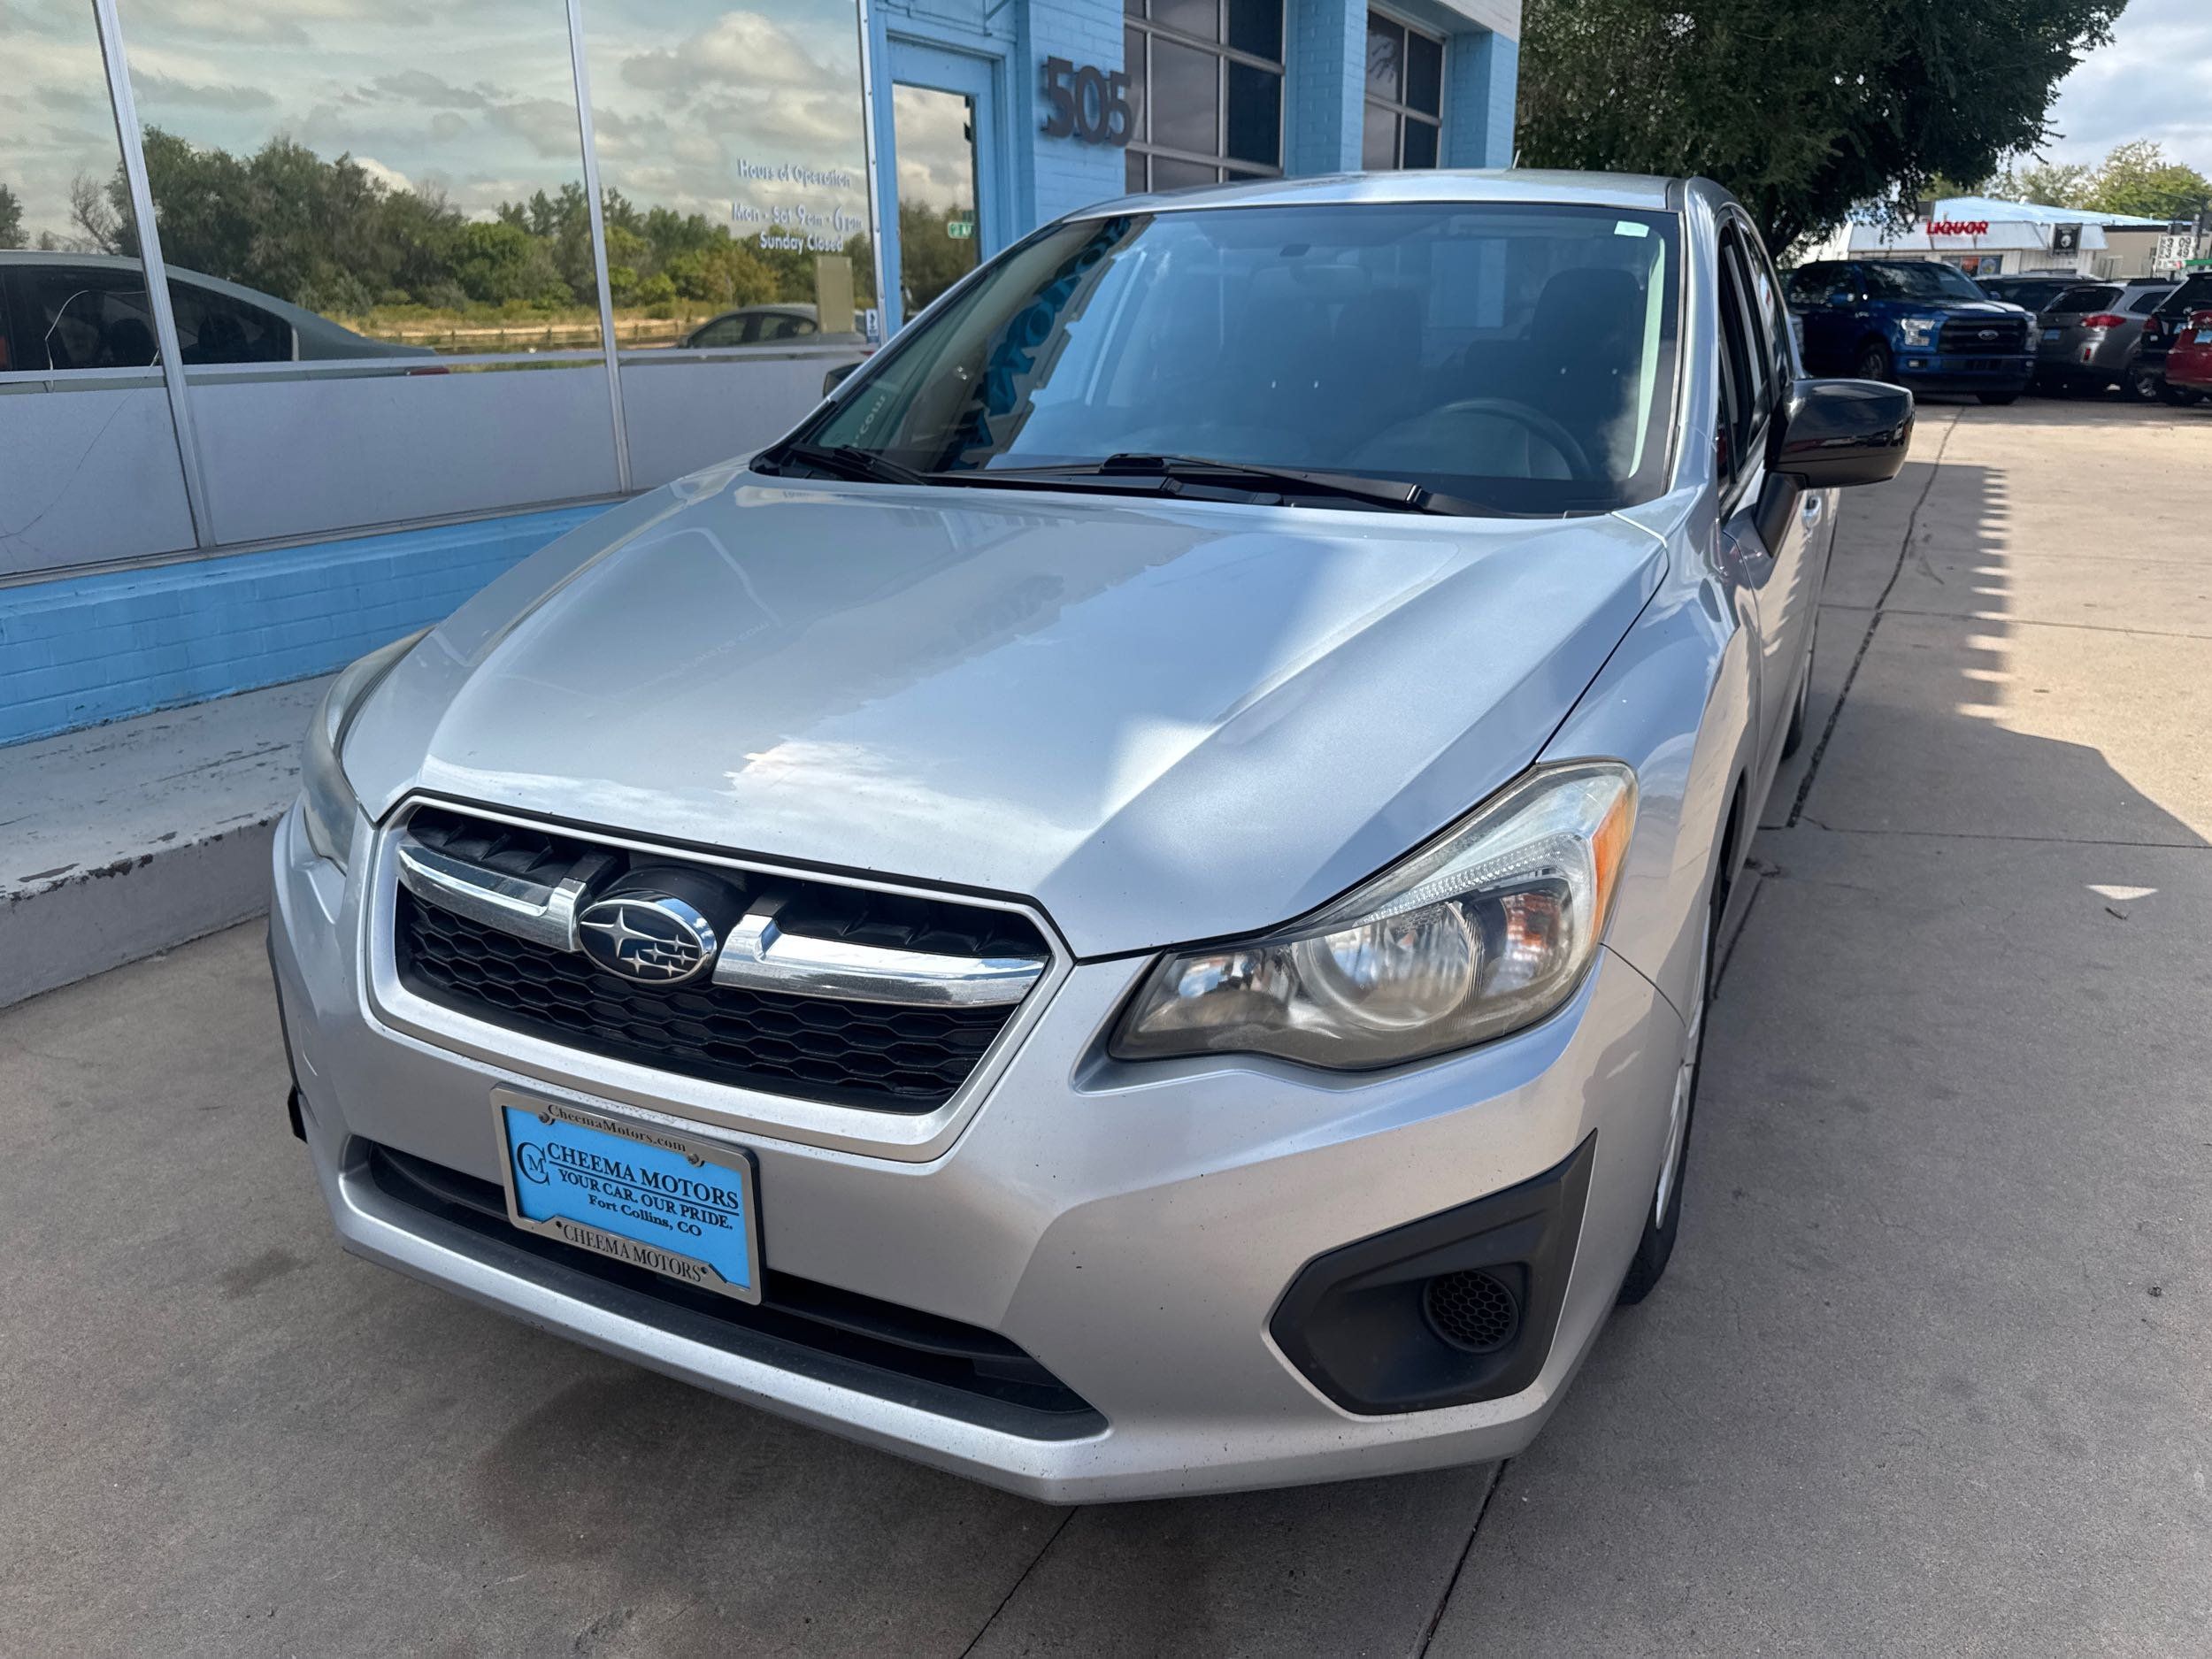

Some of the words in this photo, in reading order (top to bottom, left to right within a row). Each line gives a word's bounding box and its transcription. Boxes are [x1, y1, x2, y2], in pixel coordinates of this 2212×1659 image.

[1047, 56, 1133, 147] 505
[738, 157, 773, 180] Hours
[780, 164, 790, 181] of
[794, 165, 850, 188] Operation
[733, 202, 759, 221] Mon
[772, 205, 791, 224] Sat
[797, 204, 823, 227] 9am
[1926, 219, 1989, 235] LIQUOR
[760, 231, 803, 255] Sunday
[807, 234, 843, 252] Closed
[548, 1104, 686, 1152] CheemaMotors.com
[547, 1142, 636, 1182] CHEEMA
[640, 1167, 739, 1210] MOTORS
[558, 1168, 601, 1193] YOUR
[603, 1182, 638, 1203] CAR.
[641, 1194, 678, 1215] OUR
[680, 1203, 733, 1230] PRIDE.
[588, 1194, 618, 1213] Fort
[620, 1204, 673, 1231] Collins,
[677, 1221, 703, 1236] CO
[563, 1225, 630, 1259] CHEEMA
[634, 1246, 702, 1283] MOTORS
